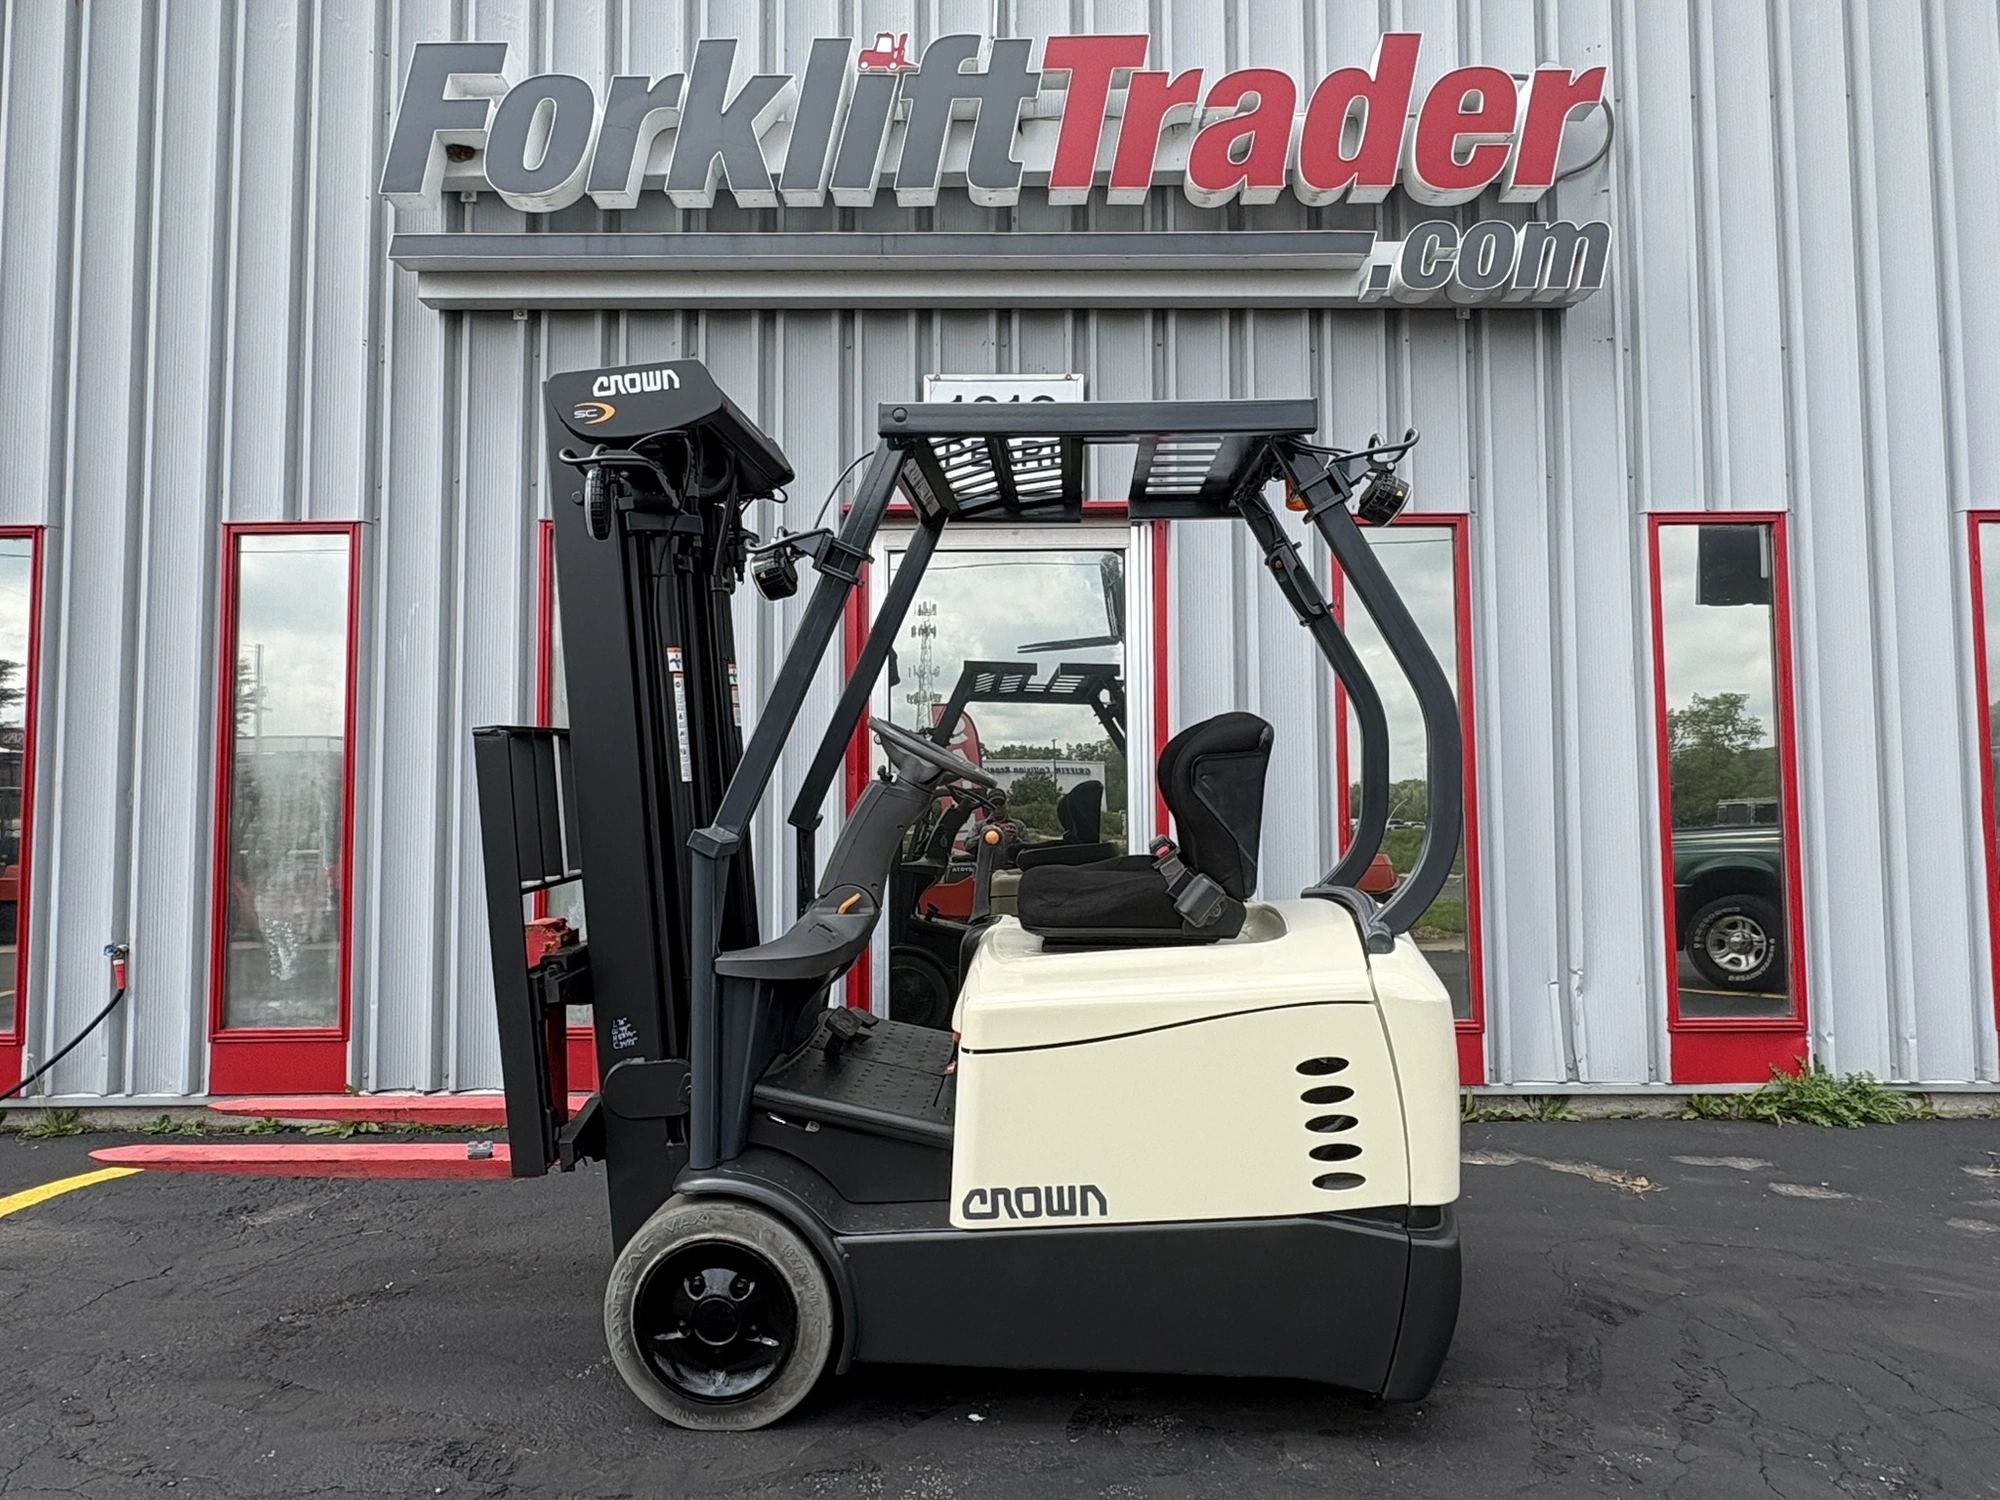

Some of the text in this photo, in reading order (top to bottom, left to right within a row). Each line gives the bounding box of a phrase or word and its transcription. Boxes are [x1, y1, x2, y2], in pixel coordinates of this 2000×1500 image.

[1367, 220, 1611, 294] .com
[592, 369, 681, 397] CROWN
[574, 408, 598, 419] SC
[962, 1184, 1108, 1219] CROWN
